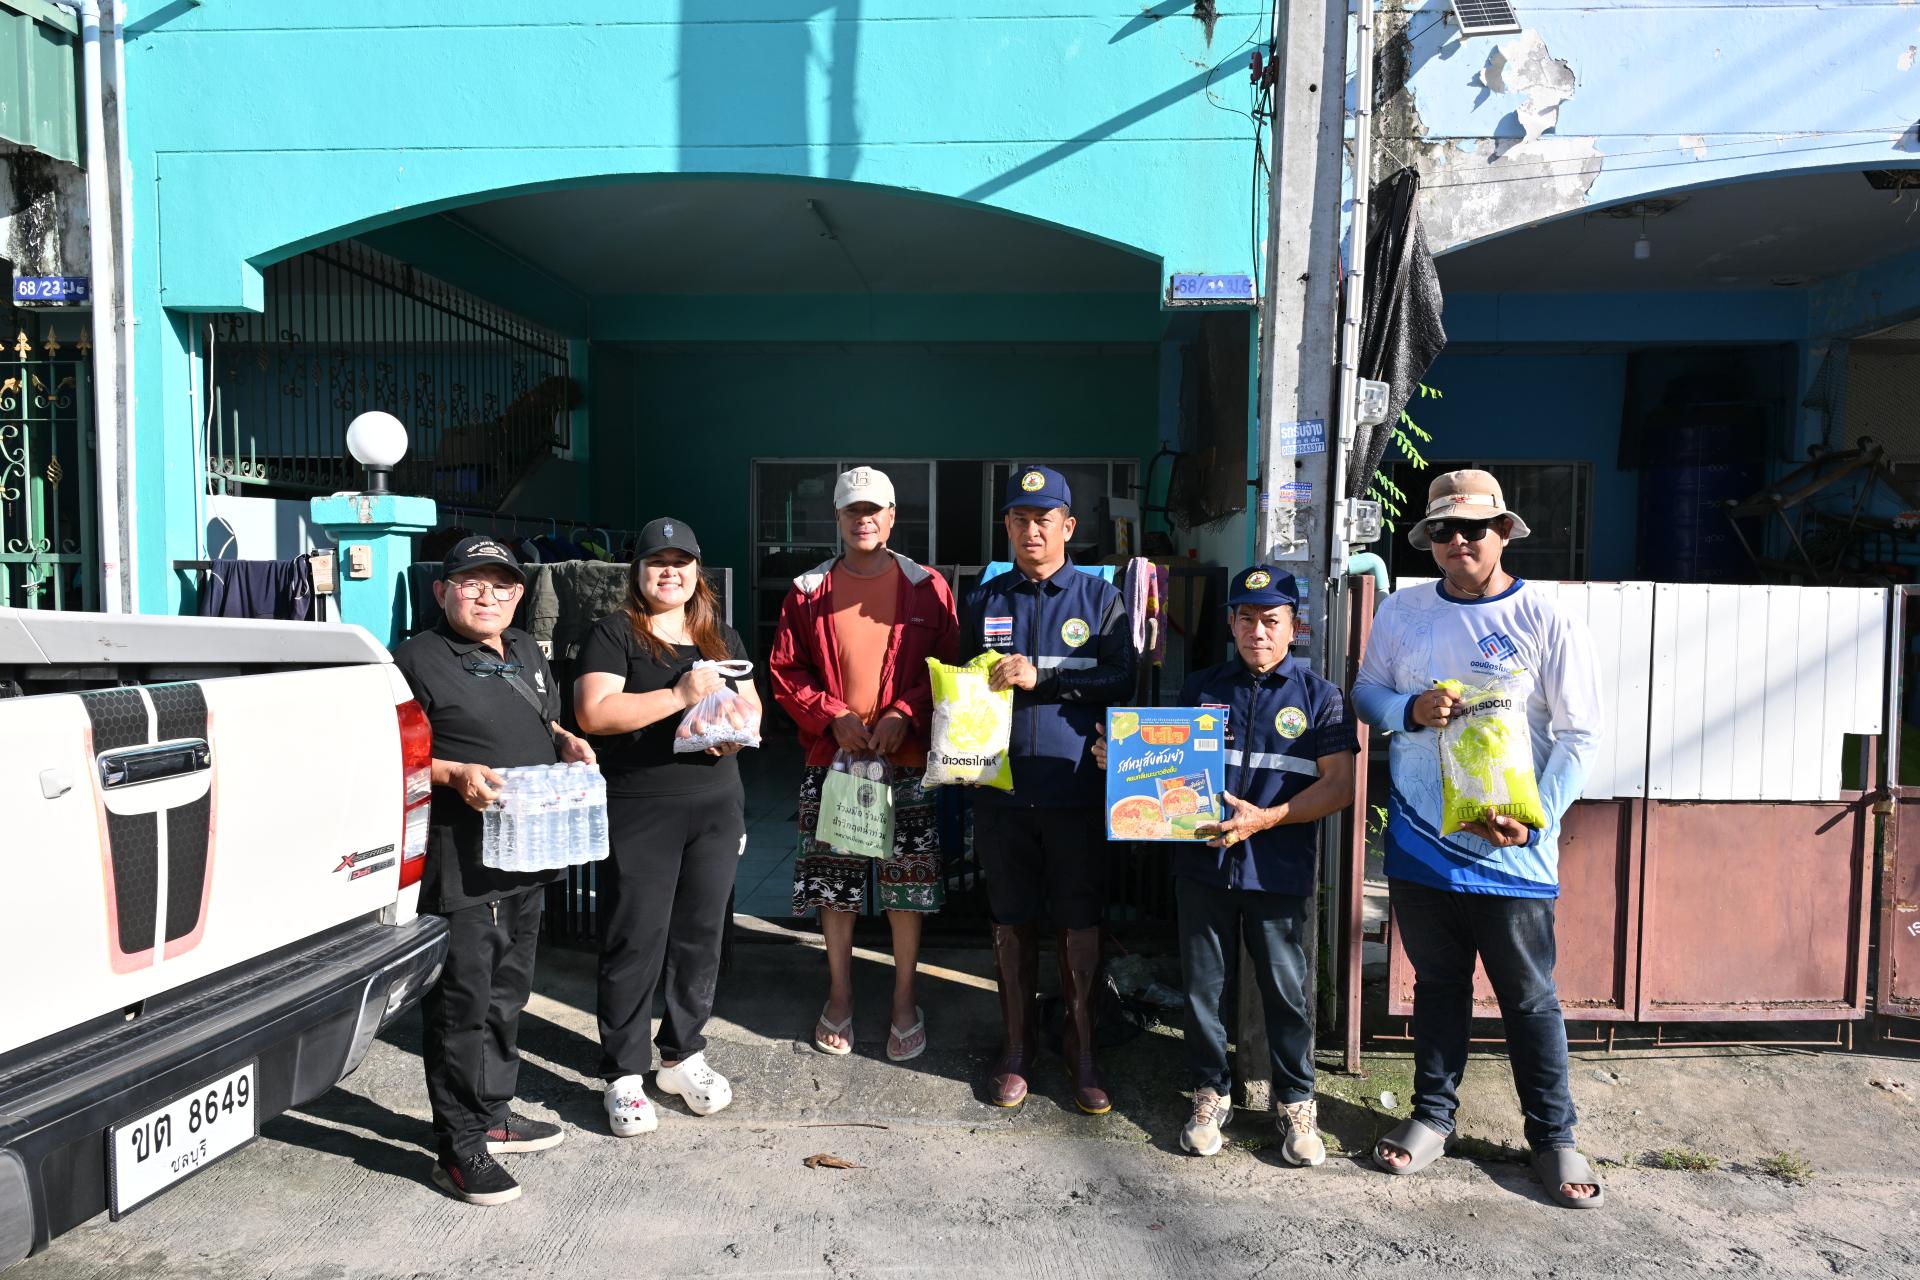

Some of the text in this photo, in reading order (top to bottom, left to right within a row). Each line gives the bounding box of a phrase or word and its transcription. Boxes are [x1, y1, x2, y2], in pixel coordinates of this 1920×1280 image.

[19, 280, 61, 297] 68/23
[1281, 421, 1323, 439] รถรับจ้าง
[853, 471, 872, 487] B
[1117, 747, 1185, 774] รสหมูสับต้มยำ
[131, 1074, 250, 1164] ขต 8649
[170, 1137, 208, 1174] ชลบุรี
